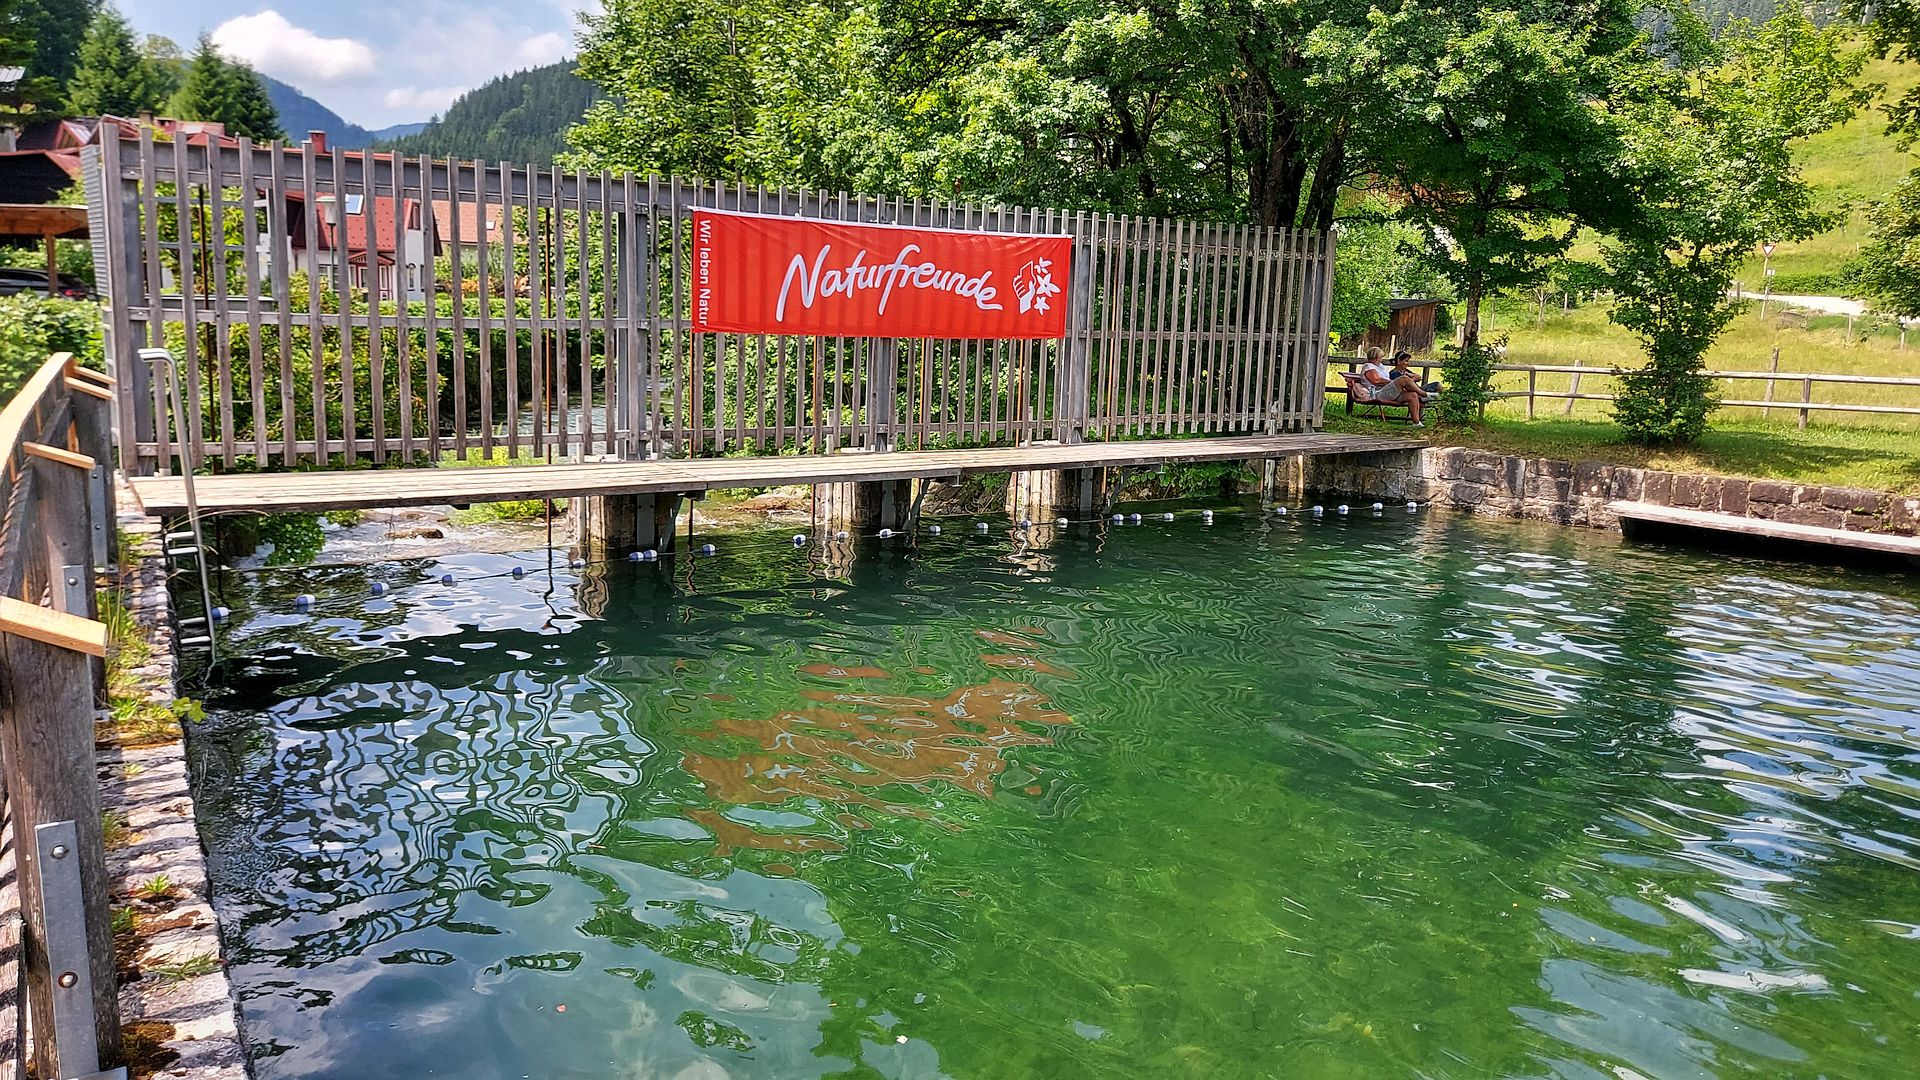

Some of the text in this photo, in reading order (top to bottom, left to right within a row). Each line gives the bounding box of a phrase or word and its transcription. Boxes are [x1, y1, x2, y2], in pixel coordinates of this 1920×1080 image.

[698, 219, 712, 326] Wir leben Natur
[775, 244, 1003, 322] Naturfreunde
